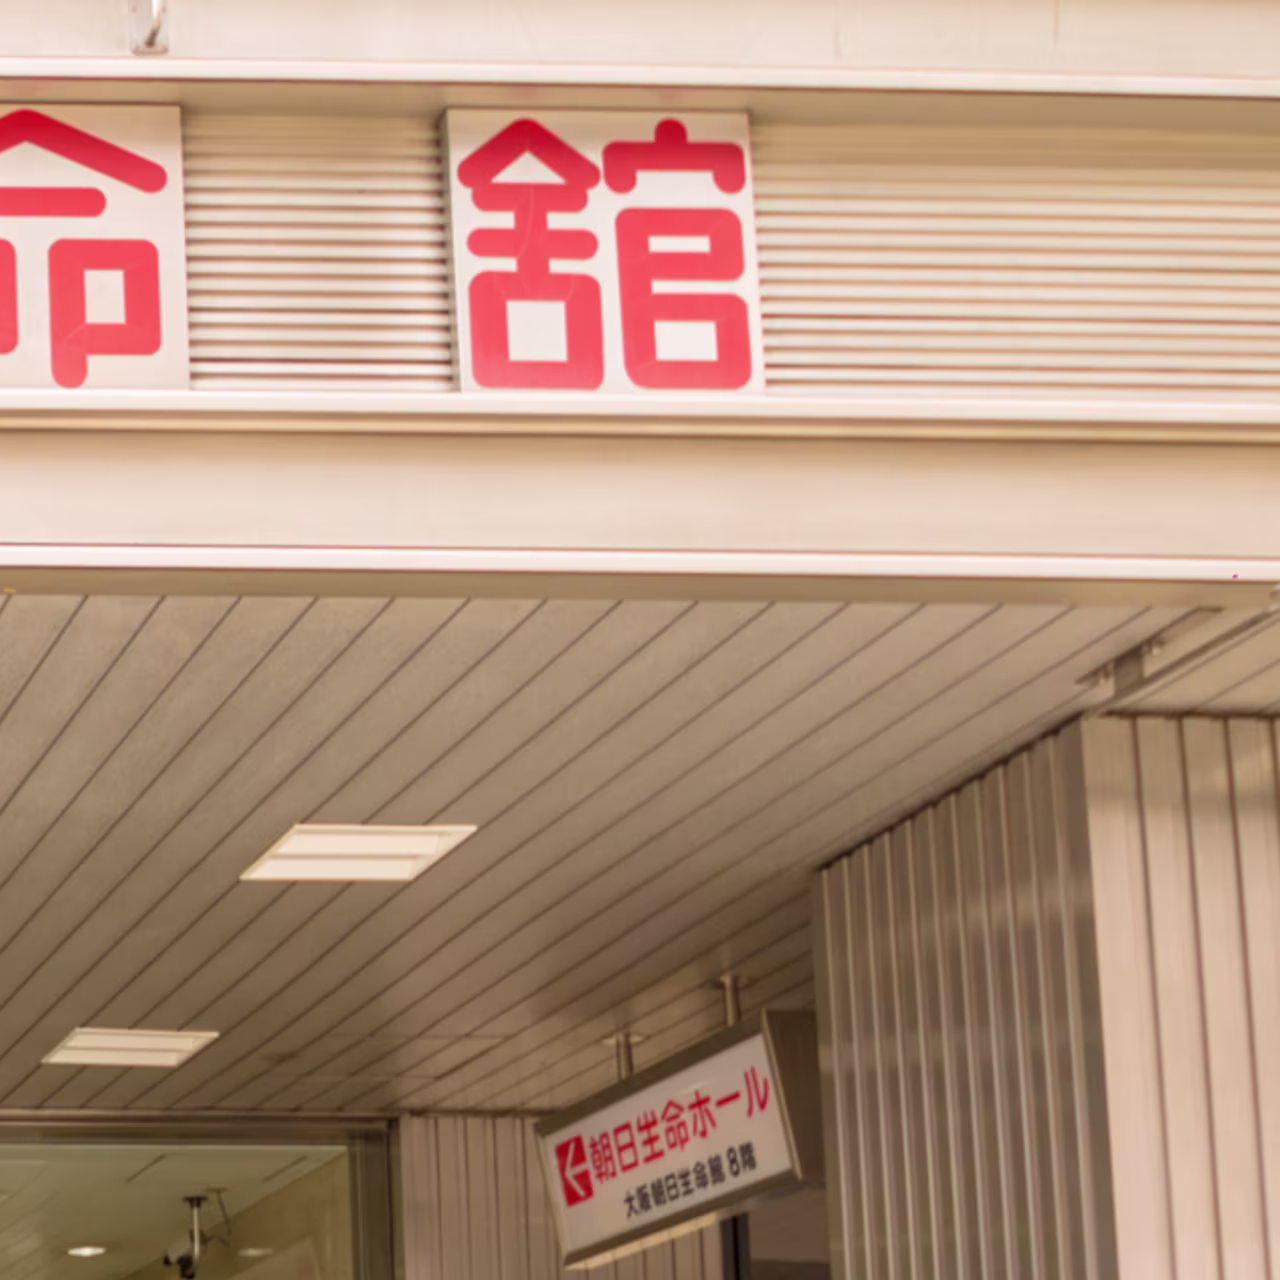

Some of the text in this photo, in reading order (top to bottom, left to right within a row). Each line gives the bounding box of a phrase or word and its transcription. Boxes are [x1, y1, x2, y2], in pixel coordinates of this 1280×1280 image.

[588, 1065, 771, 1185] 朝日生命ホール
